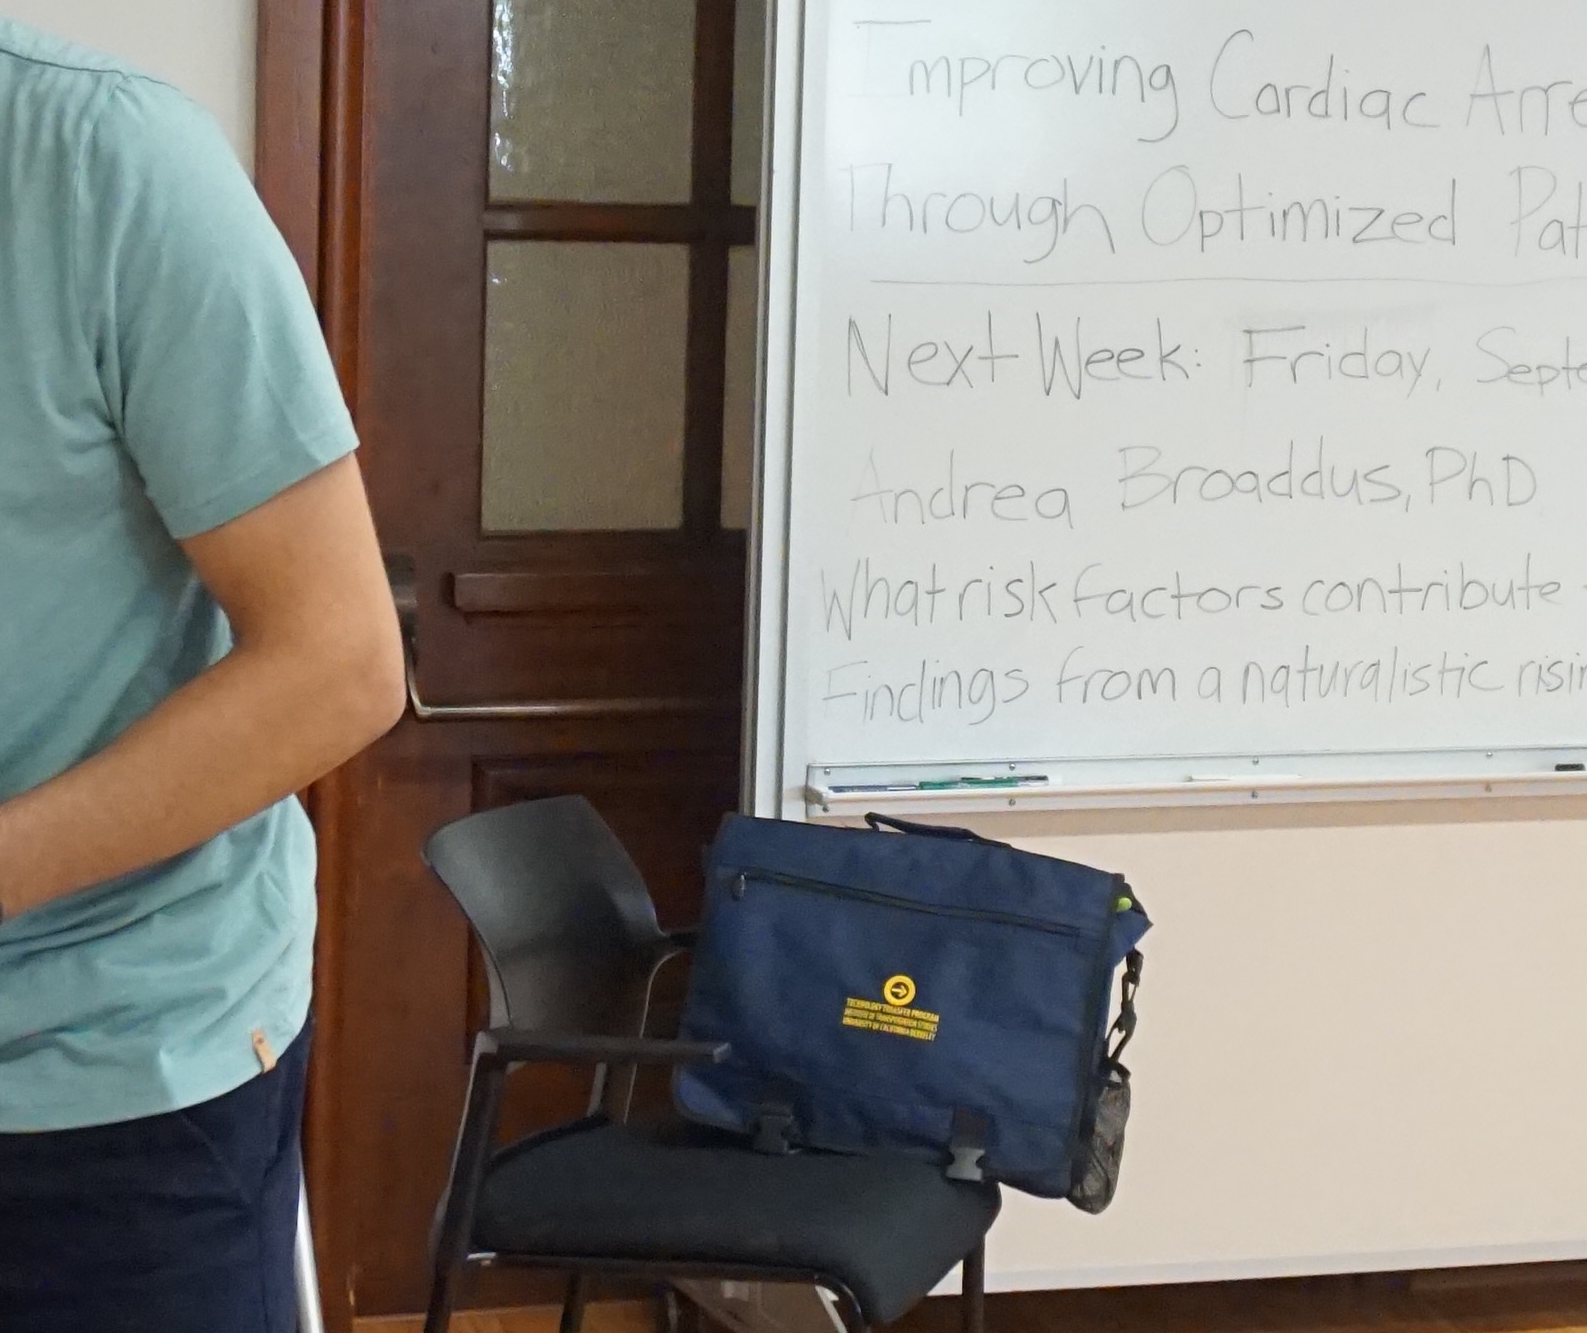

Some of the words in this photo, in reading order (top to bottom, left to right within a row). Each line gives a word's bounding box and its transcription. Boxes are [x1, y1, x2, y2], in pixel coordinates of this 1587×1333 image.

[1209, 28, 1441, 131] Cardiac
[841, 162, 1116, 266] Through
[1141, 163, 1458, 255] Optimized
[847, 309, 1020, 398] Next
[1035, 311, 1202, 400] Week:
[1242, 324, 1442, 399] Friday,
[846, 446, 1074, 533] Andrea
[1425, 444, 1538, 508] PhD
[821, 556, 947, 642] What
[957, 560, 1059, 625] risk
[1072, 561, 1283, 623] factors
[1301, 551, 1562, 617] contribute
[821, 657, 1030, 727] Findings
[1056, 645, 1178, 705] from
[1197, 664, 1223, 703] a
[1241, 645, 1505, 709] naturalistic
